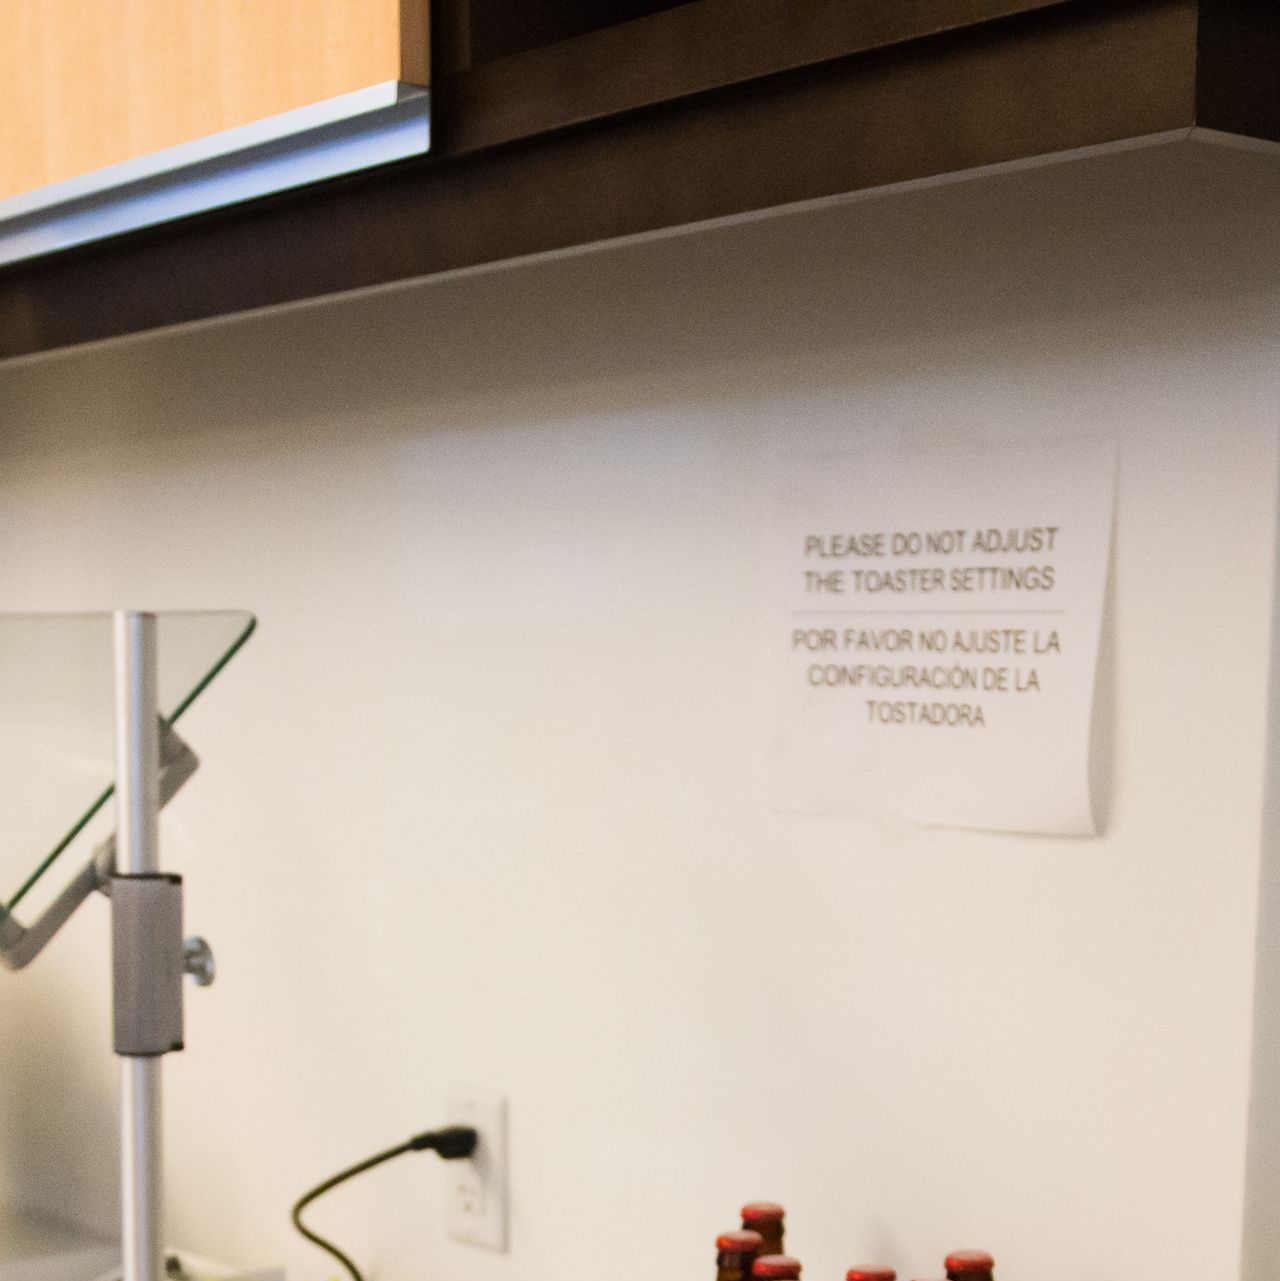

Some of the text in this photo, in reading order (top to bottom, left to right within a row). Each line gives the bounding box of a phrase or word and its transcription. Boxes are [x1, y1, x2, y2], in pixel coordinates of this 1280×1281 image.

[804, 526, 1059, 559] PLEASE DO NOT ADJUST
[803, 565, 1056, 593] THE TOASTER SETTINGS
[792, 628, 1062, 653] POR FAVOR NO AJUSTE LA
[982, 666, 1008, 690] DE
[1014, 668, 1041, 692] LA
[866, 700, 986, 727] TOSTADORA
